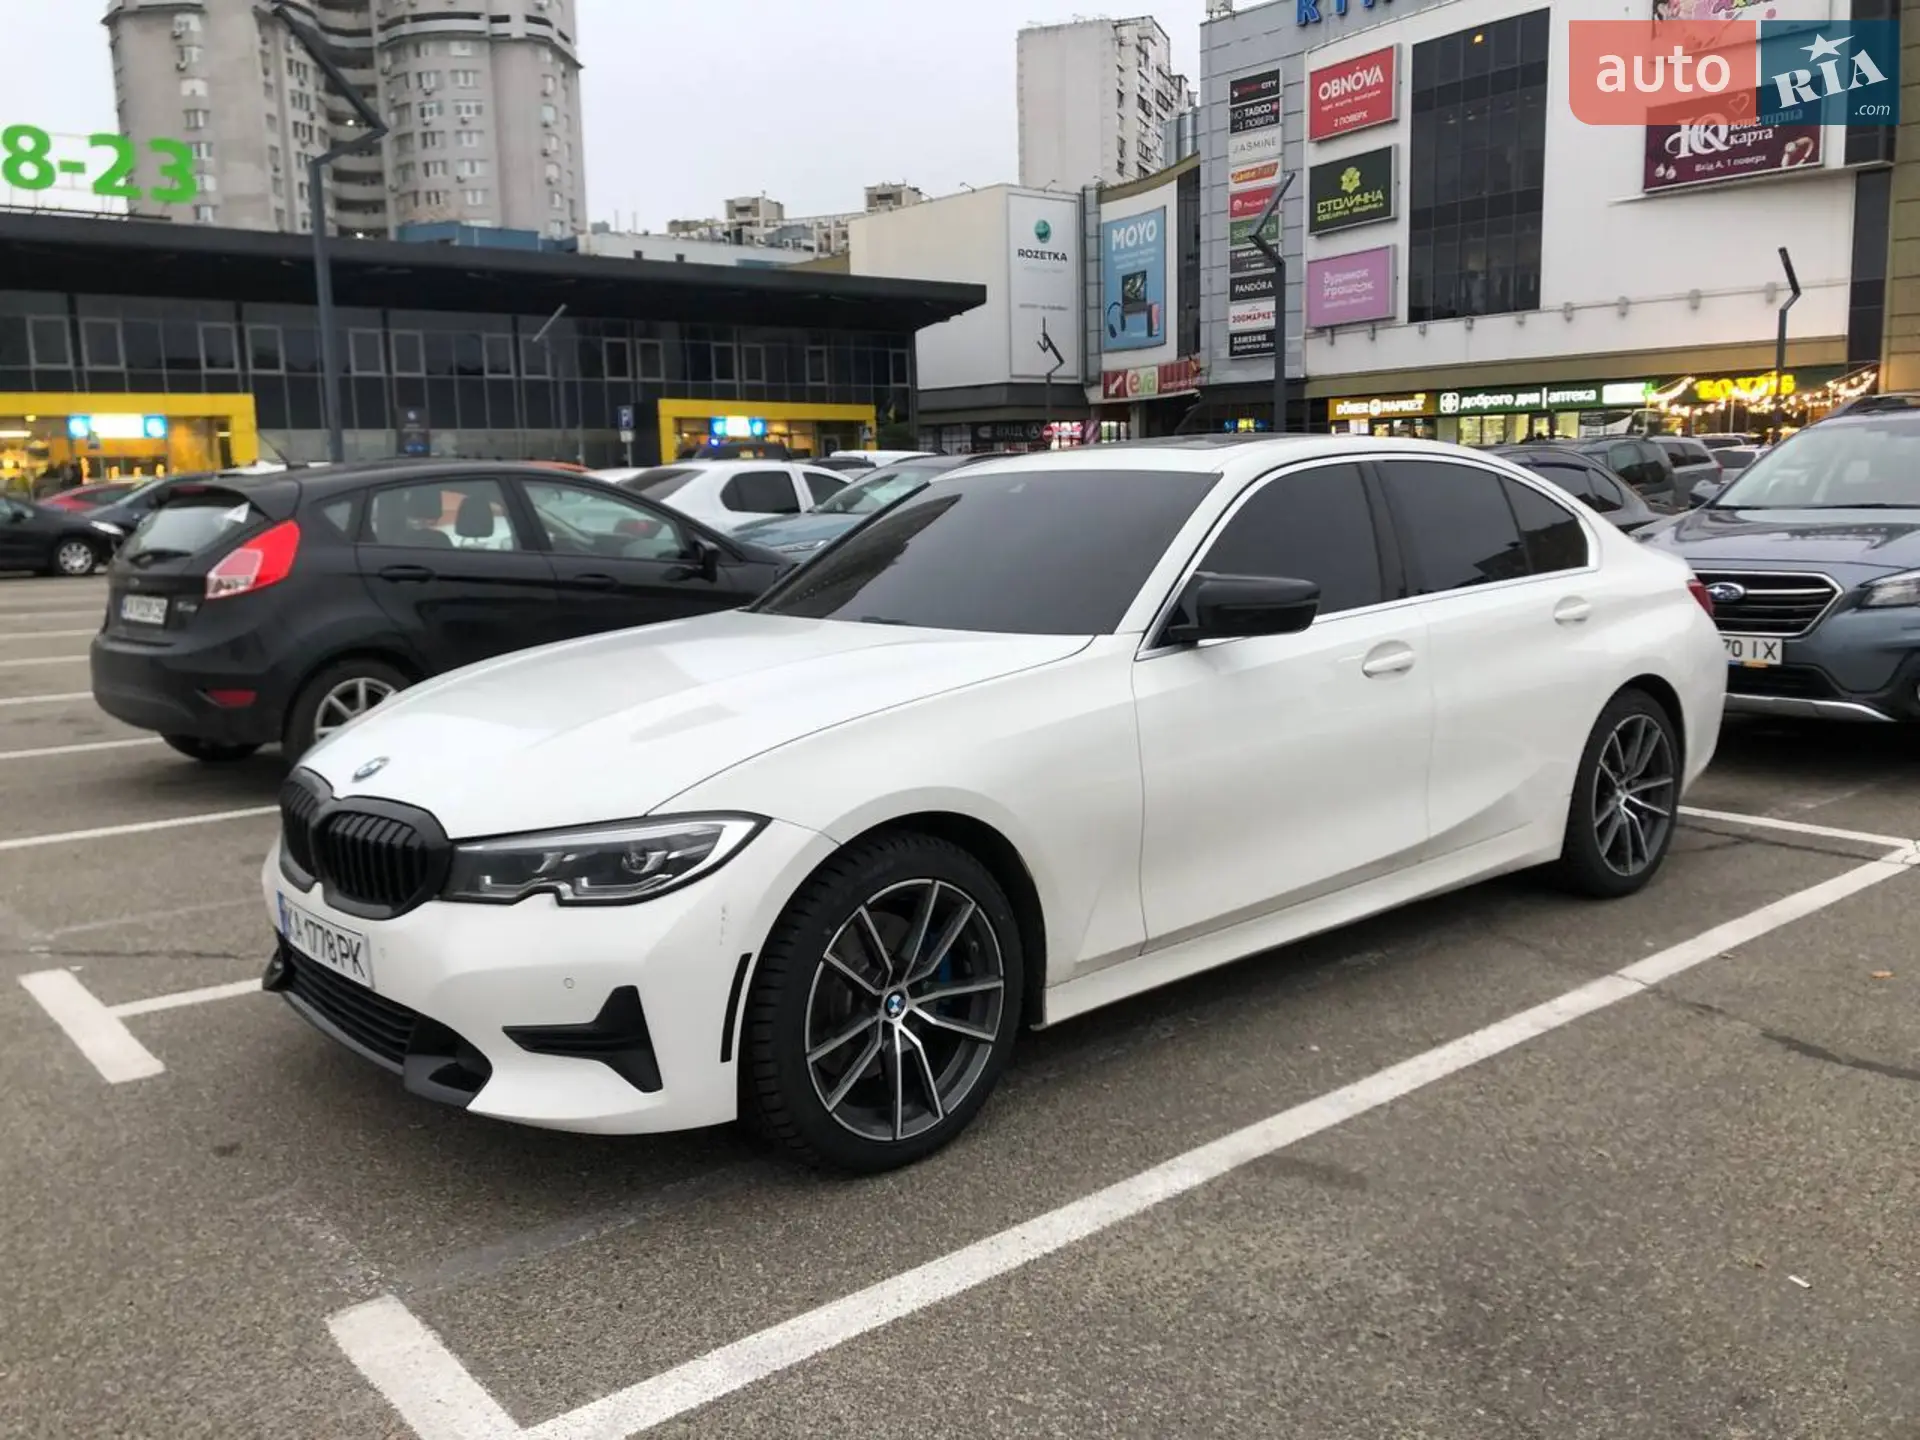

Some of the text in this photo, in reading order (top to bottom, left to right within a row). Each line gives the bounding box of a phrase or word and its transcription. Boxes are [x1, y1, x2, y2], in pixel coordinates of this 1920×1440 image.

[1233, 137, 1277, 155] JASMINE
[1729, 128, 1774, 147] карта
[2, 124, 198, 203] 8-23
[1111, 219, 1158, 251] MOYO
[1017, 248, 1068, 262] ROZETKA
[1233, 334, 1267, 344] SAMSUNG
[1461, 393, 1514, 409] доброго
[1548, 389, 1597, 401] аптека
